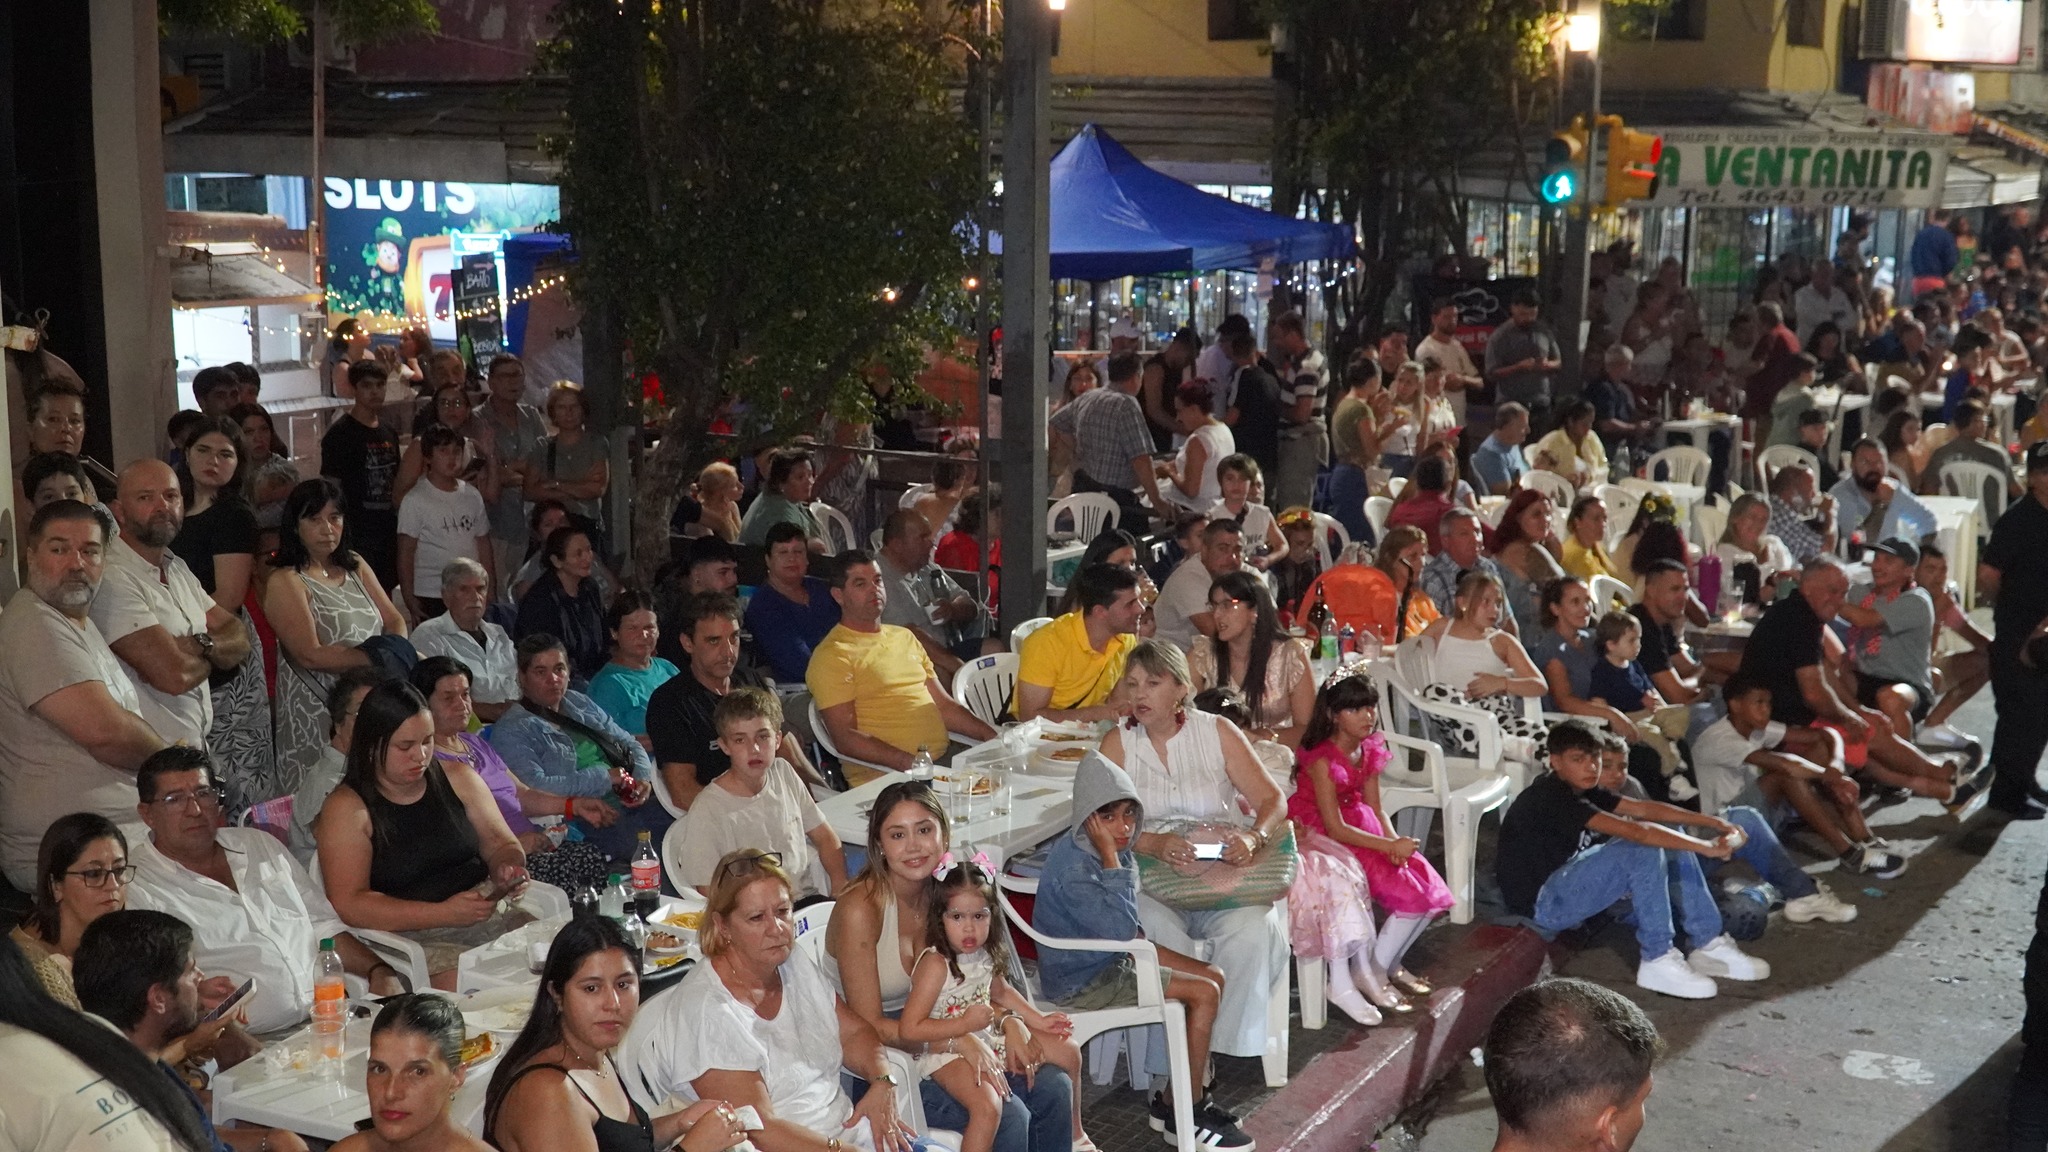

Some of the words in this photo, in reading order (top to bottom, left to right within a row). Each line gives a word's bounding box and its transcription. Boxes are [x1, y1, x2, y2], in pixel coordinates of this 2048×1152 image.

[1652, 146, 1681, 187] A
[1705, 146, 1932, 189] VENTANITA
[1736, 190, 1804, 205] 4643
[1822, 190, 1886, 206] 0714
